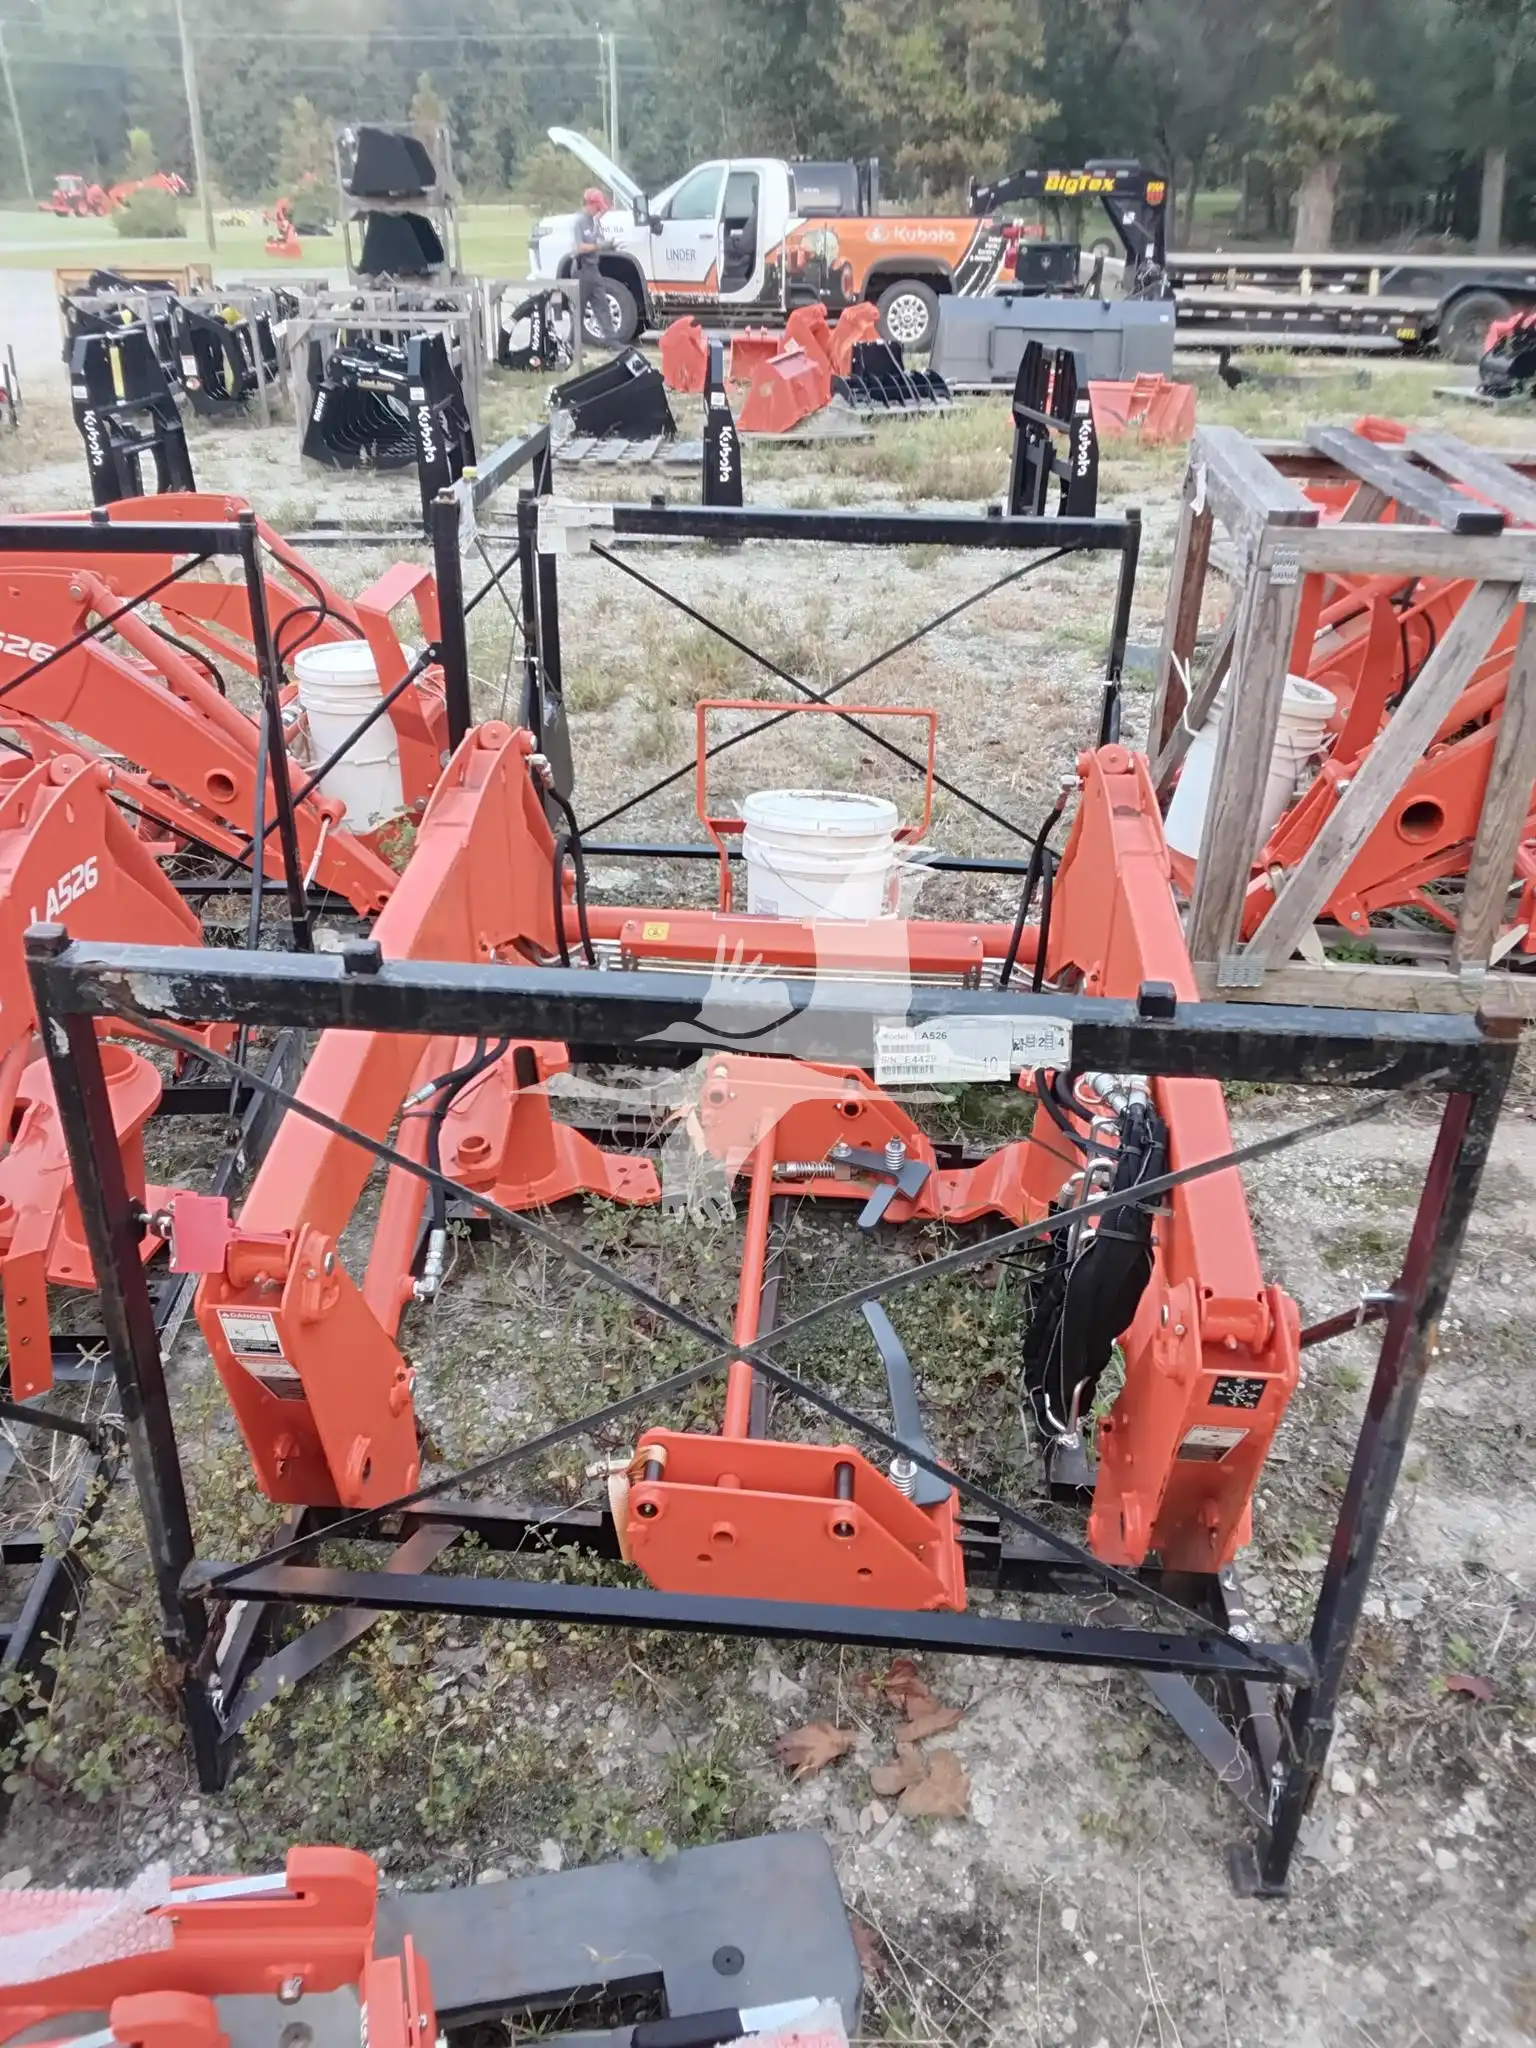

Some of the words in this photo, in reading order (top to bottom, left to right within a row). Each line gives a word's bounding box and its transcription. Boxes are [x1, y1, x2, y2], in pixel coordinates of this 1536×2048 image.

[665, 248, 697, 262] LINDER
[893, 226, 956, 243] Kubota
[83, 409, 105, 467] Kubota
[418, 405, 437, 464] Kubota
[719, 425, 733, 482] Kubota
[1077, 419, 1092, 477] Kubota
[0, 631, 57, 663] 26
